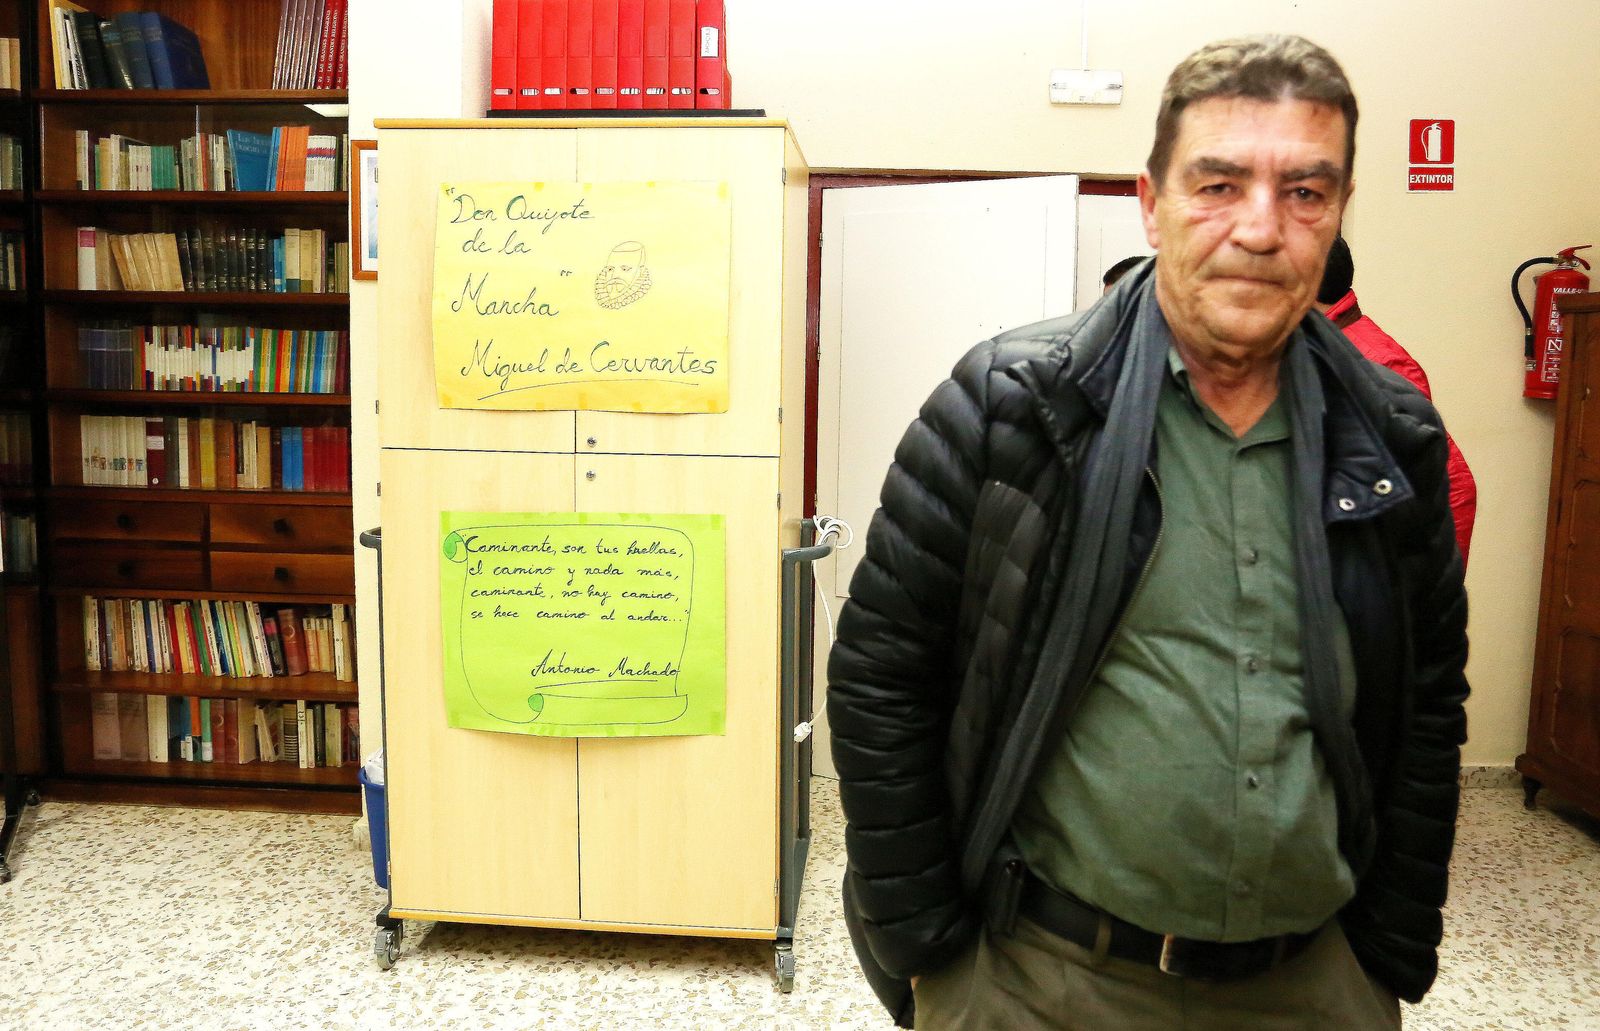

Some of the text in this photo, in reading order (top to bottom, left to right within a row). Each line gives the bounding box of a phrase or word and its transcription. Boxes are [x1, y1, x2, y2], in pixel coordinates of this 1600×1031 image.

[1409, 174, 1453, 184] EXTINTOR
[462, 227, 532, 255] de la
[461, 338, 717, 391] Miguel de Cervantes
[561, 544, 587, 554] son
[596, 538, 619, 554] tus
[626, 540, 683, 558] huellas,
[468, 559, 483, 575] el
[493, 564, 556, 575] camino
[567, 567, 576, 586] y
[584, 563, 624, 575] nada
[561, 589, 582, 598] no
[587, 584, 612, 606] hay
[621, 590, 679, 602] camino,
[470, 610, 483, 619] se
[536, 609, 590, 619] camino
[600, 608, 616, 621] al
[531, 648, 681, 678] Antonio Machado
